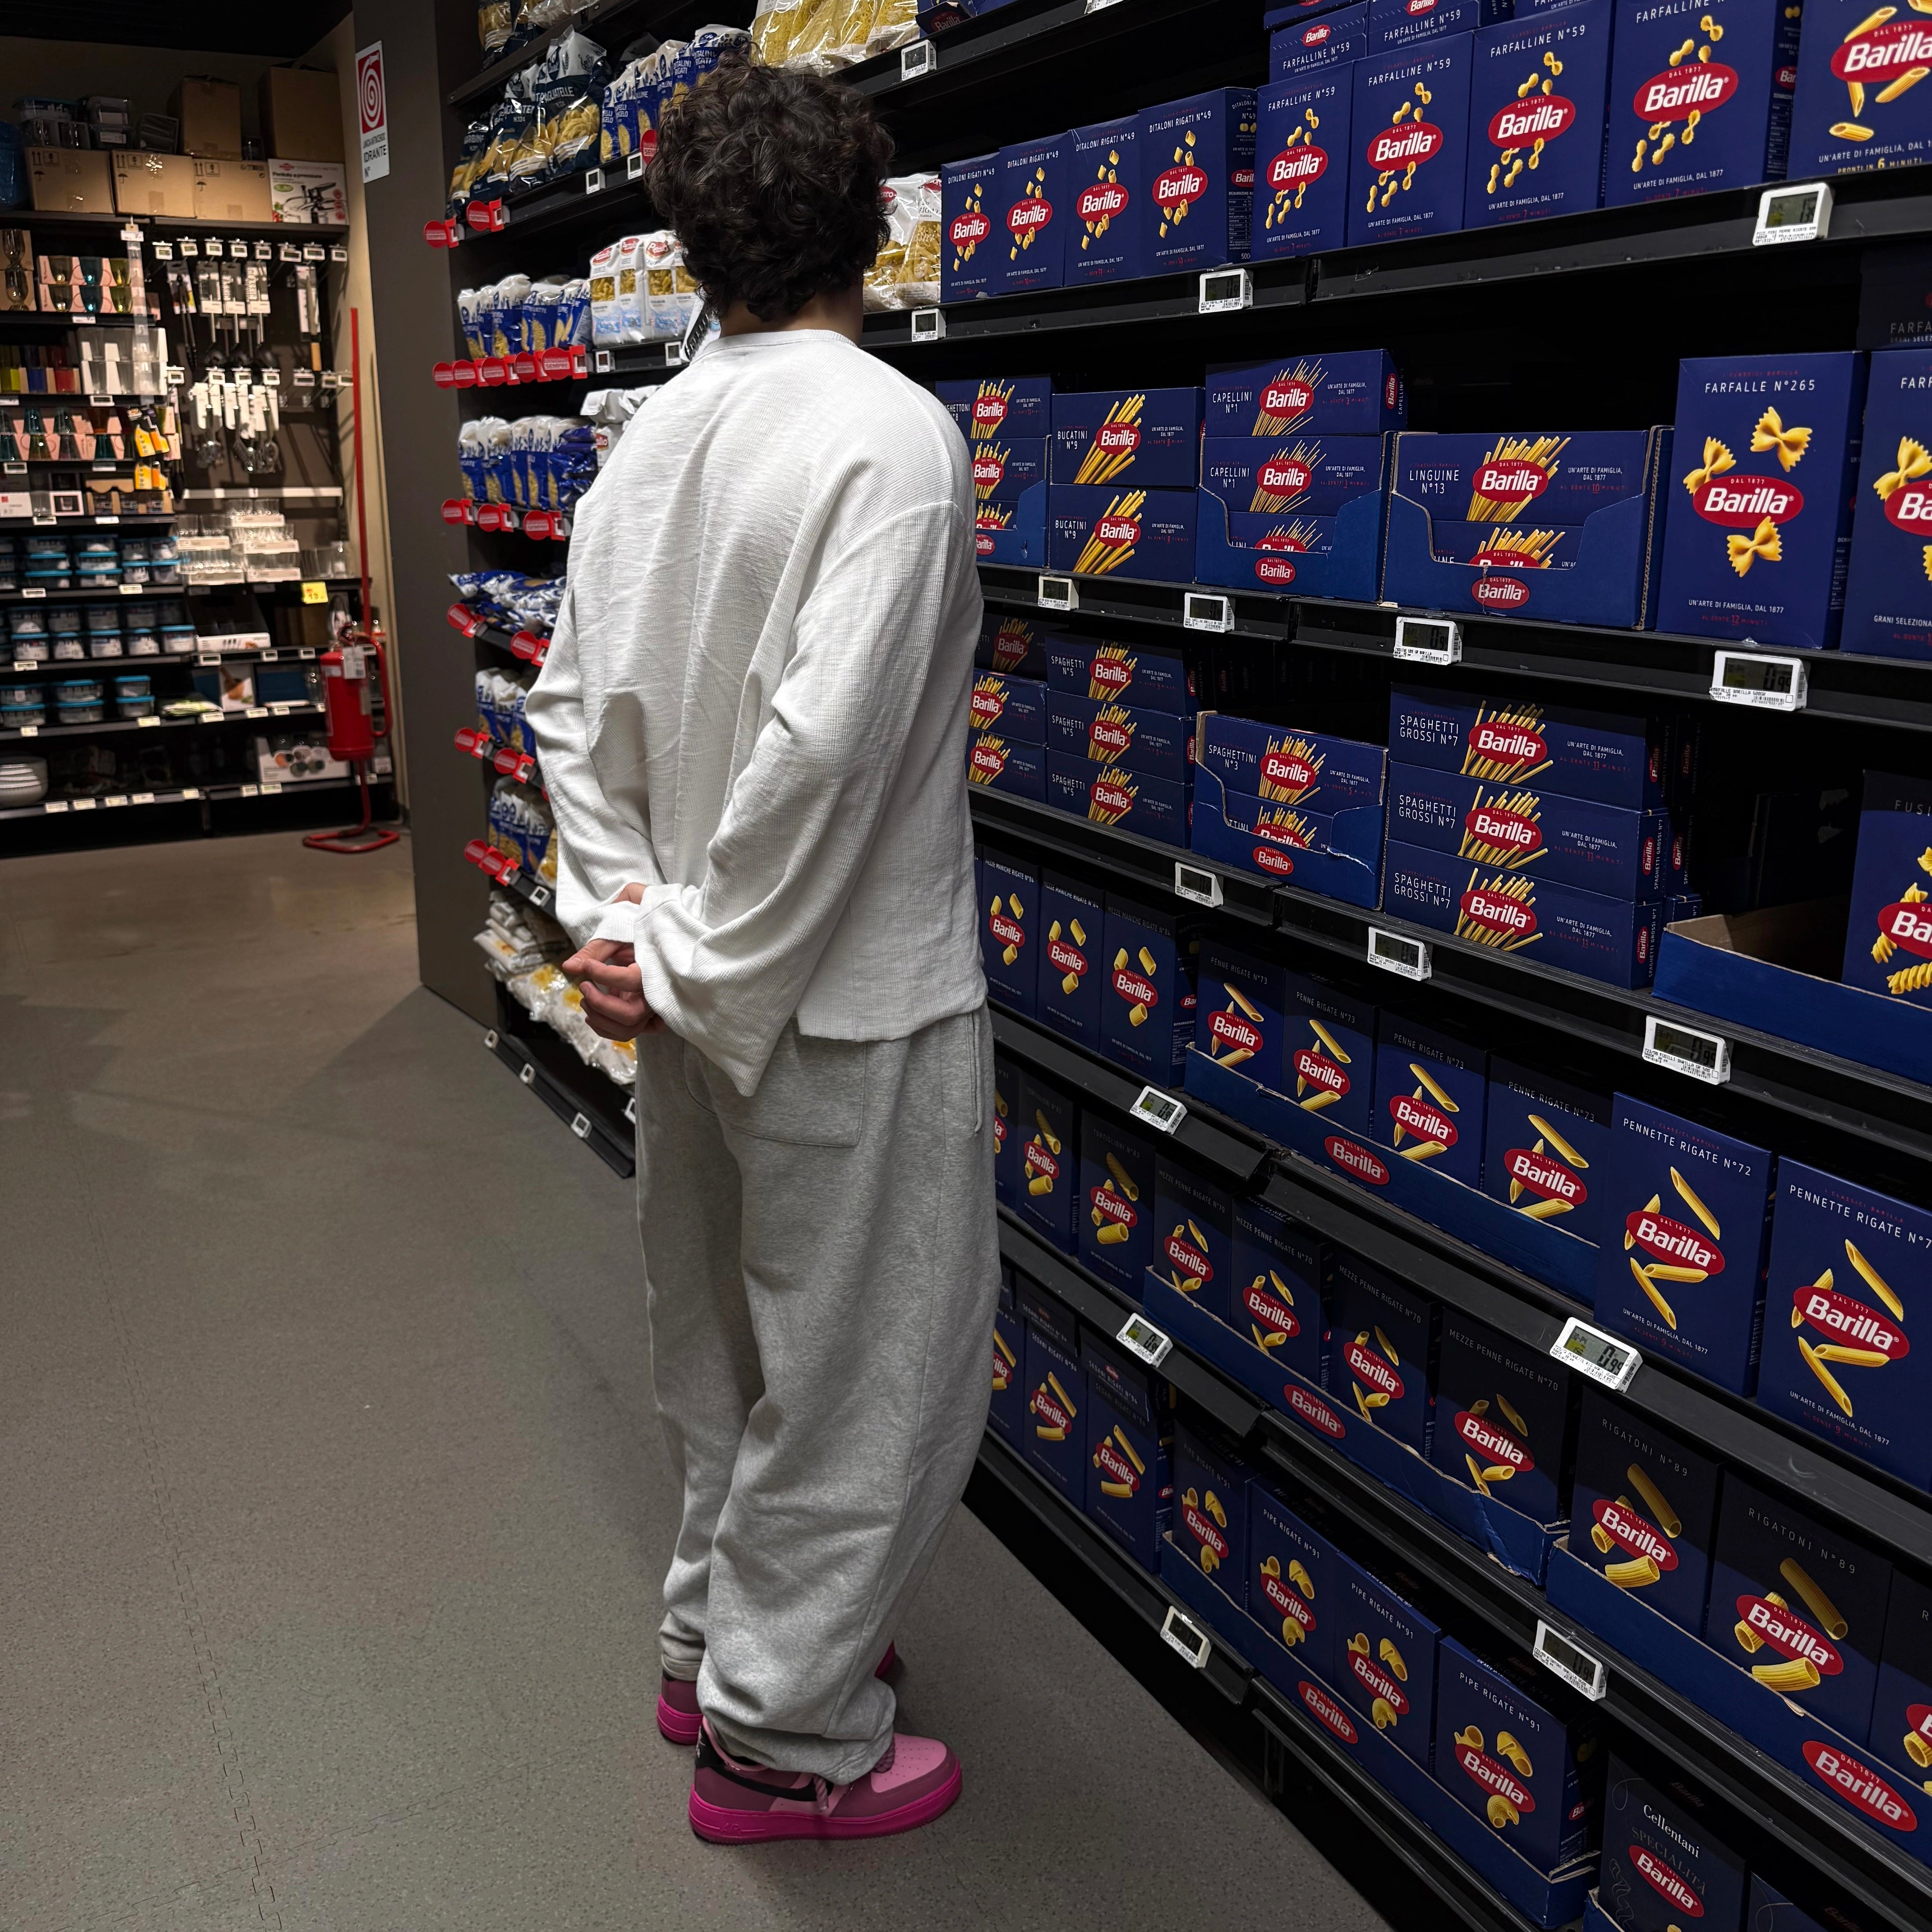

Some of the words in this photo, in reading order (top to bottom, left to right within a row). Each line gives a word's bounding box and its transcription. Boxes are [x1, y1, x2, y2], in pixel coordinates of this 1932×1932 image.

[1637, 0, 1709, 23] FARFALLINE
[1306, 28, 1329, 42] Barilla
[1491, 33, 1551, 57] FARFALLINE
[1283, 49, 1327, 70] FARFALLINE
[1369, 65, 1421, 86] FARFALLINE
[1645, 74, 1723, 111] Barilla
[1150, 120, 1173, 133] DITALONI
[1176, 115, 1193, 125] RIGATI
[1498, 105, 1563, 138] Barilla
[364, 145, 387, 162] IDRANTE
[1375, 131, 1432, 161] Barilla
[1273, 154, 1319, 181] Barilla
[1878, 158, 1884, 168] 6
[1159, 174, 1200, 199] Barilla
[1634, 180, 1656, 189] UN'ARTE
[1082, 190, 1121, 213] Barilla
[954, 220, 984, 239] Barilla
[1213, 392, 1251, 402] CAPELLINI
[1266, 388, 1306, 407] Barilla
[1706, 382, 1766, 393] FARFALLE
[977, 402, 1003, 417] Barilla
[1058, 431, 1087, 439] BUCATINI
[1101, 430, 1135, 445] Barilla
[1263, 468, 1304, 486] Barilla
[1410, 470, 1458, 480] LINGUINE
[1481, 470, 1538, 490] Barilla
[1705, 488, 1788, 513] Barilla
[1100, 523, 1134, 539] Barilla
[1261, 564, 1290, 578] Barilla
[1478, 584, 1522, 600] Barilla
[1052, 656, 1084, 671] SPAGHETTI
[1095, 664, 1126, 682] Barilla
[973, 695, 999, 713] Barilla
[1095, 726, 1125, 745] Barilla
[1400, 715, 1458, 734] SPAGHETTI
[1400, 727, 1435, 742] GROSSI
[1209, 745, 1256, 764] SPAGHETTINI
[1478, 730, 1536, 757] Barilla
[1267, 759, 1308, 782] Barilla
[1475, 814, 1532, 844] Barilla
[1258, 851, 1288, 870] Barilla
[1394, 873, 1451, 897] SPAGHETTI
[1395, 884, 1427, 902] GROSSI
[1109, 906, 1120, 916] MEZZE
[1122, 912, 1141, 925] MANICHE
[1142, 920, 1157, 931] RIGATE
[1470, 897, 1527, 928] Barilla
[993, 919, 1021, 942] Barilla
[1211, 957, 1228, 969] PENNE
[1231, 965, 1250, 978] RIGATE
[1117, 975, 1151, 1001] Barilla
[1214, 1017, 1255, 1046] Barilla
[1509, 1082, 1535, 1099] PENNE
[1540, 1094, 1569, 1112] RIGATE
[1397, 1102, 1448, 1139] Barilla
[1624, 1118, 1674, 1146] PENNETTE
[1681, 1141, 1717, 1163] RIGATE
[1334, 1142, 1380, 1178] Barilla
[1513, 1155, 1575, 1197] Barilla
[1095, 1191, 1131, 1221] Barilla
[1790, 1185, 1850, 1217] PENNETTE
[1857, 1212, 1901, 1237] RIGATE
[1637, 1219, 1711, 1266] Barilla
[1249, 1293, 1292, 1330] Barilla
[1834, 1295, 1846, 1304] DAL
[1852, 1302, 1868, 1313] 1877
[1806, 1295, 1893, 1350] Barilla
[1450, 1329, 1473, 1348] MEZZE
[1477, 1344, 1502, 1363] PENNE
[1506, 1359, 1533, 1379] RIGATE
[1350, 1348, 1396, 1392] Barilla
[1292, 1391, 1337, 1432] Barilla
[1790, 1391, 1815, 1408] UN'ARTE
[1860, 1427, 1871, 1437] DAL
[1875, 1434, 1889, 1444] 1877
[1463, 1418, 1523, 1464] Barilla
[1101, 1448, 1133, 1485] Barilla
[1602, 1507, 1666, 1562] Barilla
[1749, 1508, 1811, 1550] RIGATONI
[1267, 1579, 1308, 1624] Barilla
[1352, 1583, 1366, 1600] PIPE
[1370, 1598, 1393, 1623] RIGATE
[1748, 1604, 1828, 1666] Barilla
[1355, 1657, 1400, 1707] Barilla
[1460, 1673, 1478, 1690] PIPE
[1483, 1686, 1516, 1714] RIGATE
[1306, 1688, 1350, 1736] Barilla
[1464, 1752, 1523, 1804] Barilla
[1841, 1754, 1857, 1768] DAL
[1861, 1766, 1879, 1783] 1877
[1815, 1750, 1902, 1821] Barilla
[1644, 1805, 1699, 1858] Cellentani
[1638, 1854, 1693, 1908] Barilla
